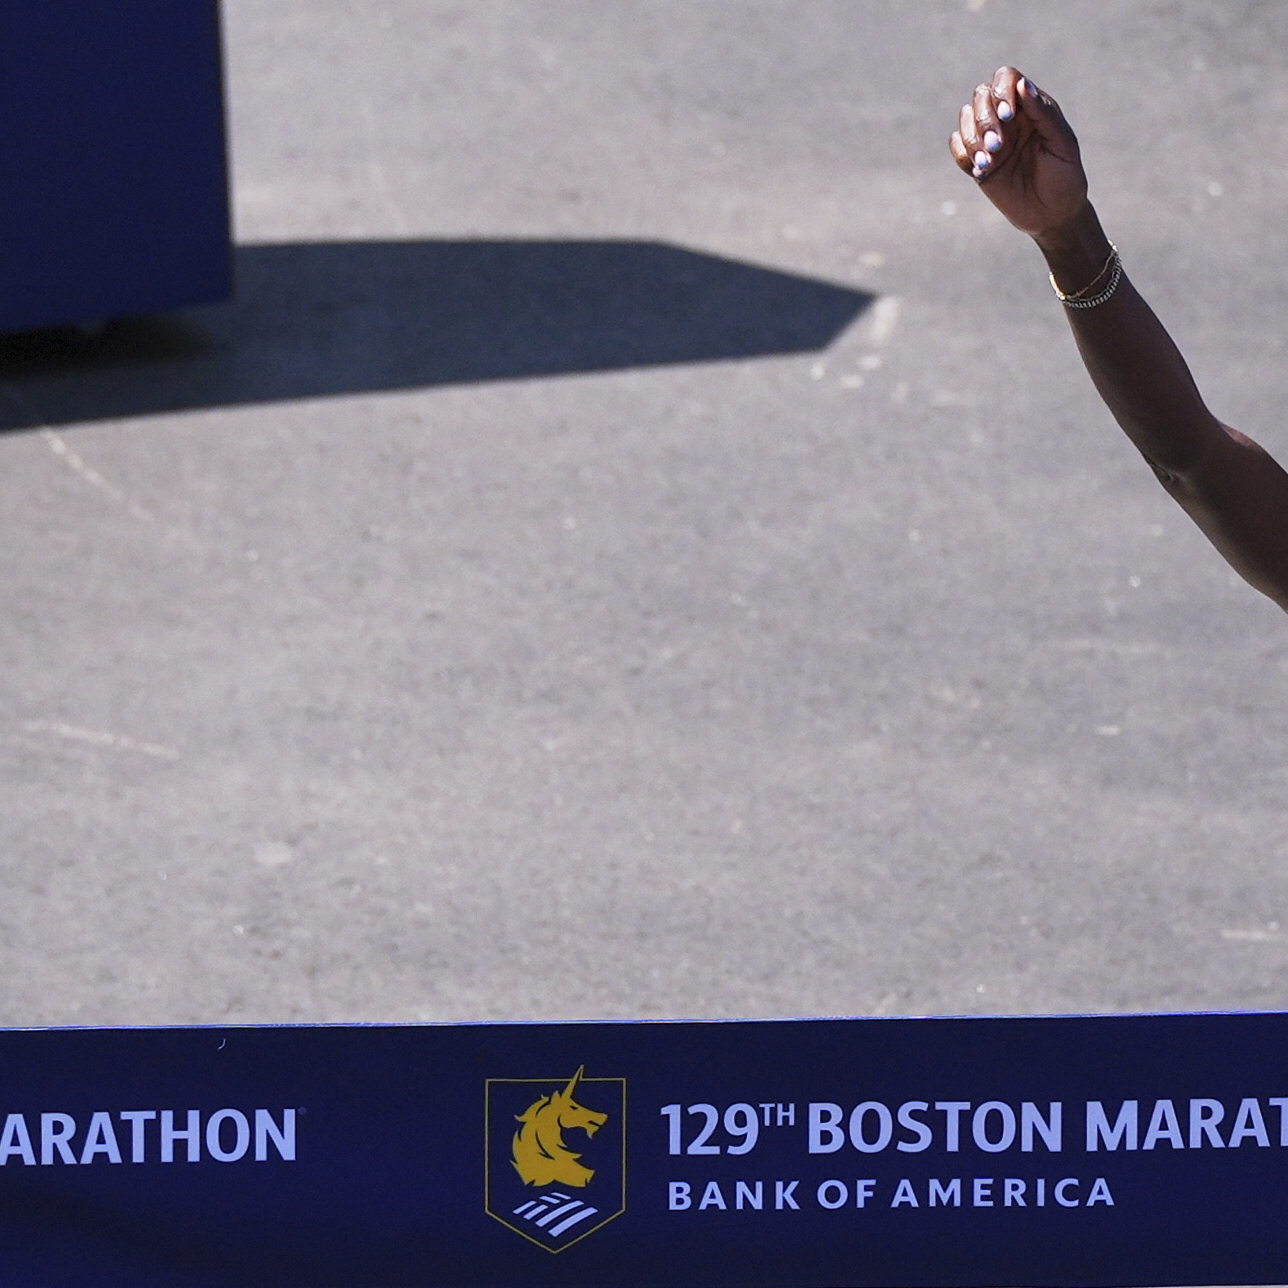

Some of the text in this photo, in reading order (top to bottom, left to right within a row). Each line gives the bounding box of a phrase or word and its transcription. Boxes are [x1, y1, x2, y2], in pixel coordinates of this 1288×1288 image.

[0, 1107, 297, 1166] ARATHON
[660, 1102, 797, 1156] 129TH
[808, 1100, 1063, 1154] BOSTON
[668, 1177, 1115, 1211] BANK OF AMERICA
